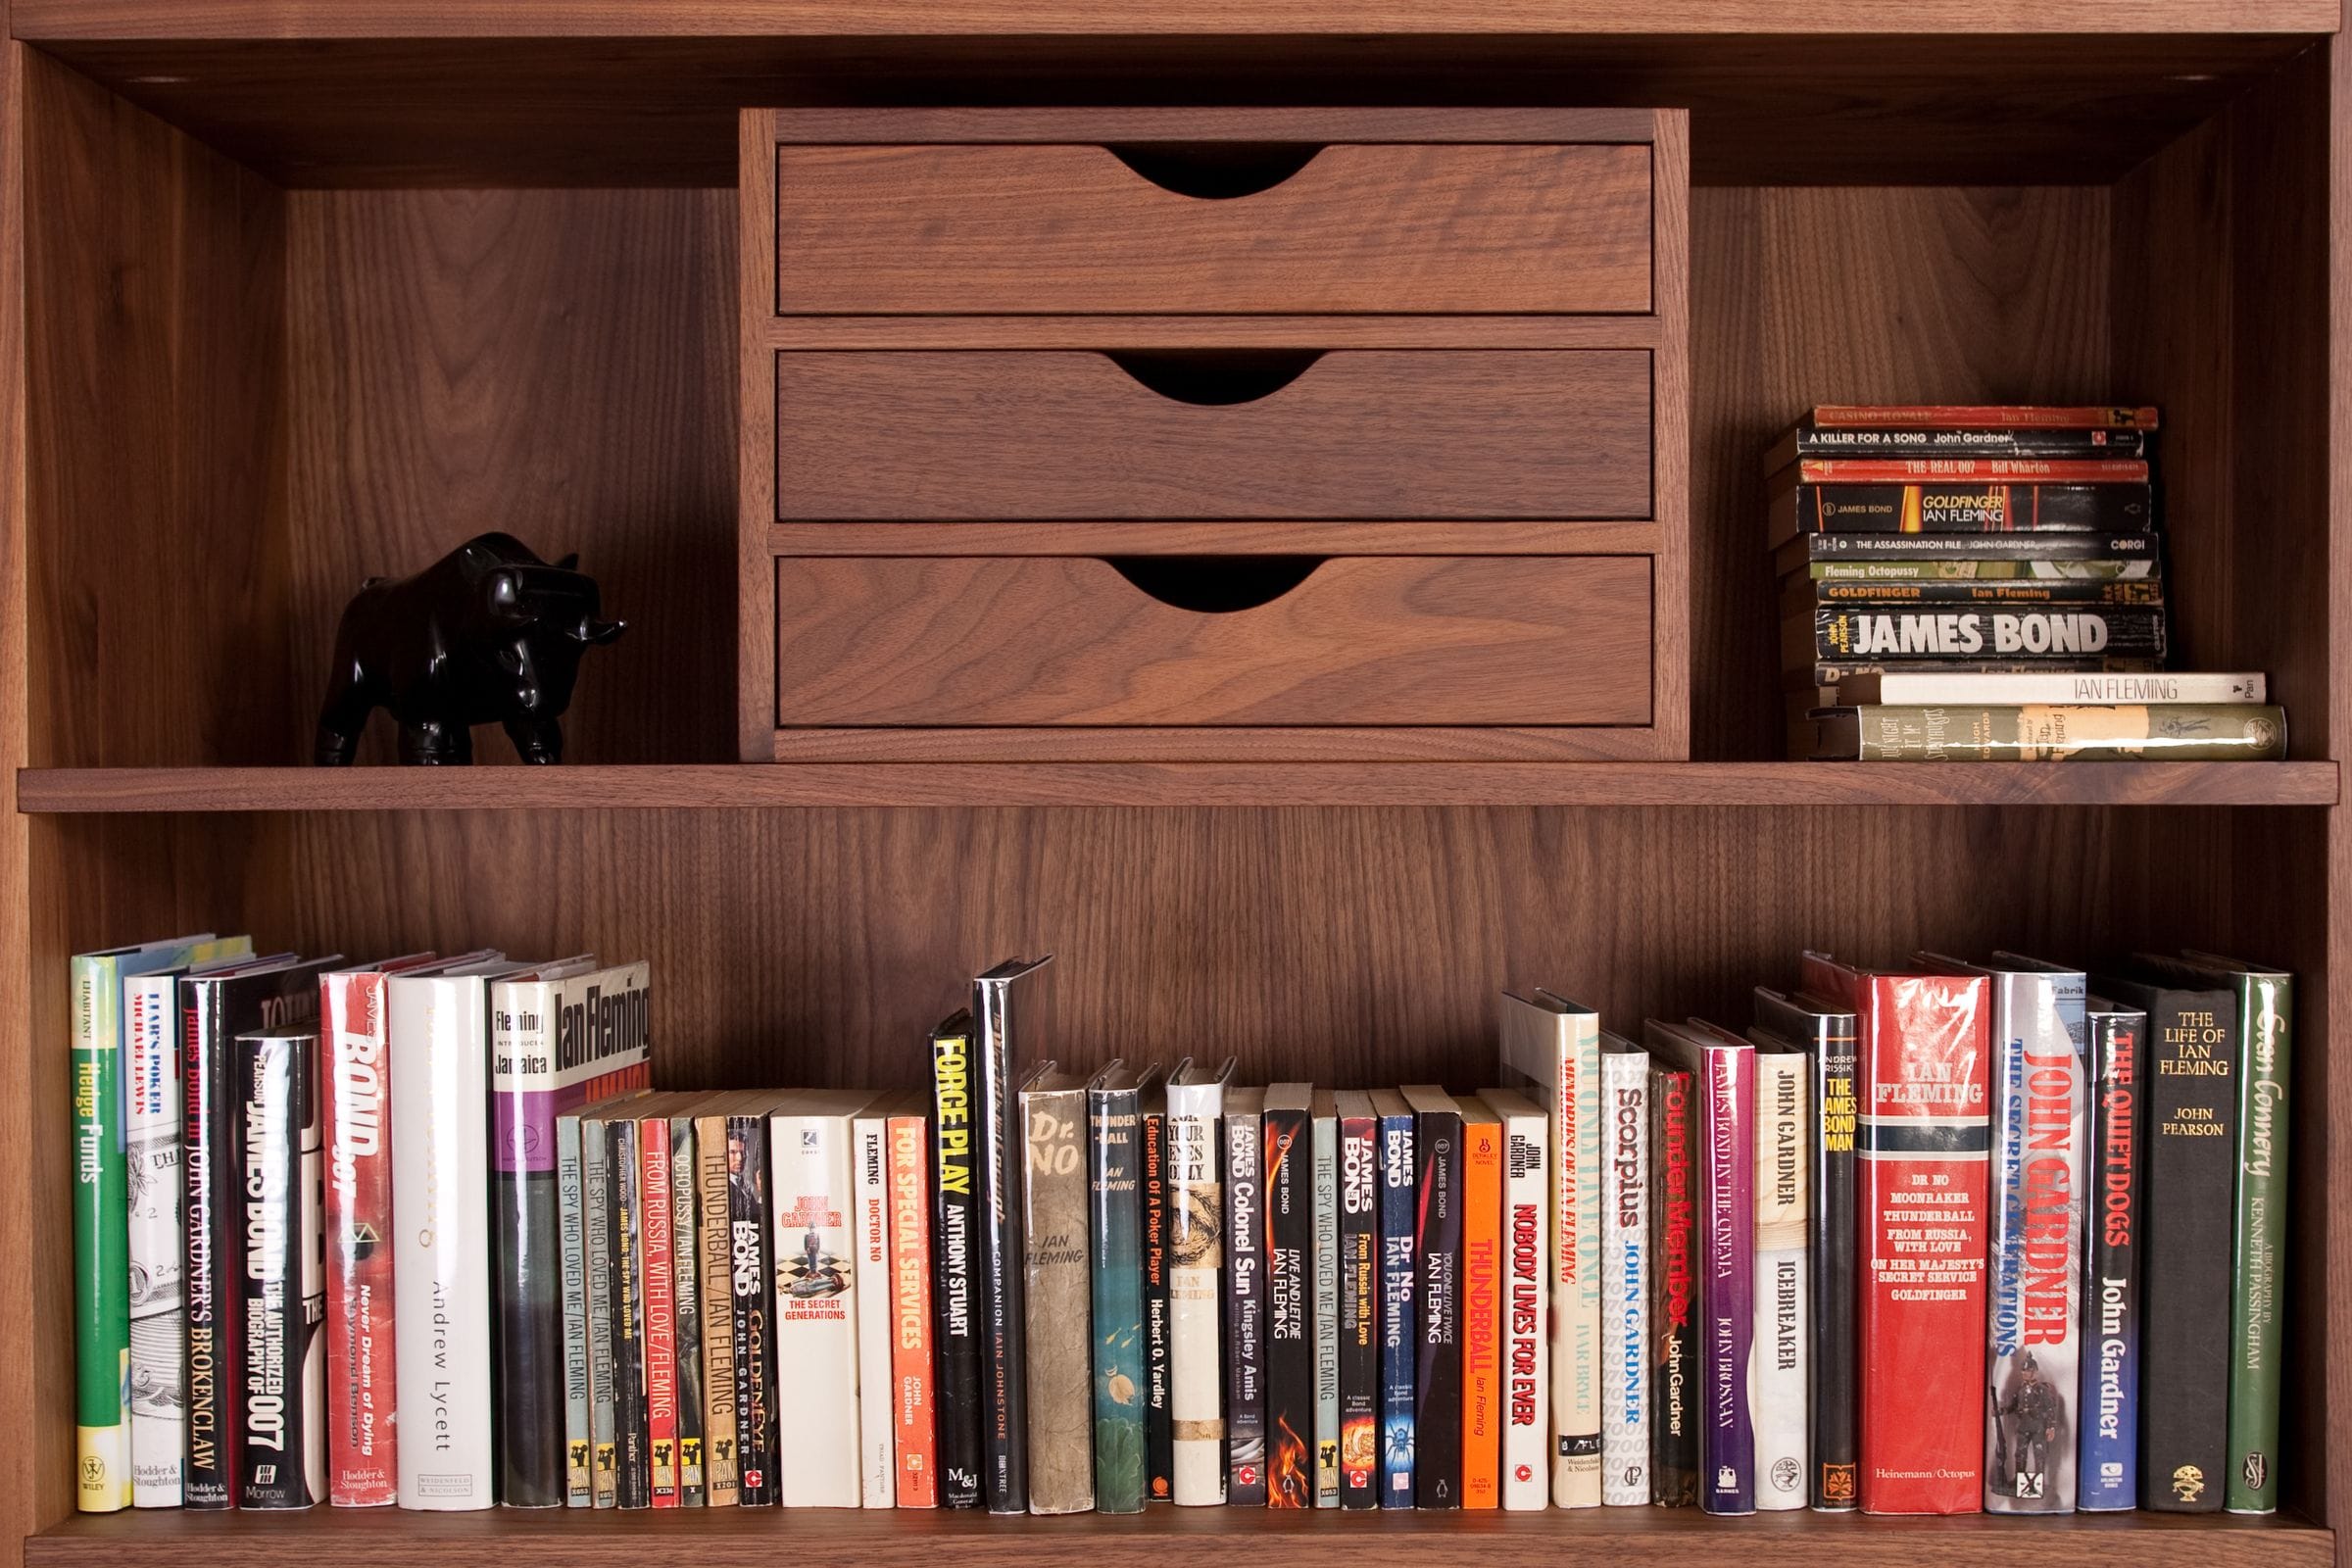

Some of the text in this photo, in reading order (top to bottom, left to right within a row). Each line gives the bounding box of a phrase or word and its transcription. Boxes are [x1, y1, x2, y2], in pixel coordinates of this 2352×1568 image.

[1809, 433, 1927, 444] A KILLER FOR A SONG
[1935, 433, 2008, 444] John Gardner
[1906, 461, 1975, 473] THE REAL 007
[1991, 461, 2050, 473] Bill Wharton
[1923, 496, 2003, 509] GOLDFINGER
[1923, 510, 2003, 521] IAN FLEMING
[1825, 565, 1919, 577] Fleming Octopussy
[1829, 588, 1921, 597] GOLDFINGER
[1972, 588, 2050, 600] Ian Fleming
[1838, 614, 1849, 653] PEARSON
[1853, 614, 1983, 654] JAMES
[1993, 613, 2107, 654] BOND
[2075, 678, 2178, 700] IAN FLEMING
[2244, 679, 2254, 699] Pan
[82, 980, 93, 1040] LHABITANT
[555, 977, 650, 1071] Ian Fleming
[2178, 1012, 2213, 1027] THE
[133, 993, 146, 1115] MICHAEL LEWIS
[148, 993, 163, 1114] LIAR'S POKER
[2164, 1028, 2226, 1043] LIFE OF
[2179, 1045, 2211, 1059] IAN
[1827, 1078, 1851, 1096] THE
[1907, 1062, 1951, 1082] IAN
[2159, 1059, 2230, 1076] FLEMING
[1877, 1083, 1984, 1103] FLEMING
[2174, 1108, 2213, 1120] JOHN
[75, 1062, 103, 1184] Hedge Funds
[935, 1038, 970, 1195] FORCE PLAY
[1029, 1111, 1074, 1144] Dr.
[1777, 1070, 1795, 1206] JOHN GARDNER
[1824, 1115, 1855, 1133] BOND
[2163, 1123, 2224, 1136] PEARSON
[2243, 1080, 2282, 1177] Connery
[866, 1134, 879, 1185] FLEMING
[1029, 1144, 1079, 1176] NO
[1231, 1124, 1246, 1179] BOND
[1244, 1124, 1254, 1178] JAMES
[1387, 1129, 1402, 1189] BOND
[1401, 1129, 1414, 1187] JAMES
[1510, 1135, 1526, 1179] GARDNER
[1526, 1144, 1542, 1170] JOHN
[1825, 1134, 1854, 1152] MAN
[2102, 1032, 2133, 1248] THE QUIET DOGS
[1344, 1137, 1361, 1214] BOND
[1360, 1138, 1373, 1212] JAMES
[1578, 1035, 1600, 1309] YOU ONLY LIVE ONCE
[1911, 1174, 1949, 1186] DR NO
[794, 1196, 829, 1212] JOHN
[1146, 1117, 1164, 1286] Education Of A Poker Player
[1884, 1210, 1975, 1222] THUNDERBALL
[1890, 1193, 1969, 1204] MOONRAKER
[2024, 1051, 2073, 1346] JOHN GARDNER
[868, 1199, 881, 1261] DOCTOR NO
[895, 1127, 922, 1349] FOR SPECIAL SERVICES
[1042, 1234, 1069, 1249] IAN
[1234, 1182, 1255, 1296] Colonel Sun
[1894, 1241, 1962, 1253] WITH LOVE
[733, 1221, 750, 1297] BOND
[947, 1204, 968, 1337] ANTHONY STUART
[1024, 1247, 1085, 1266] FLEMING
[1399, 1236, 1414, 1301] Dr No
[1614, 1089, 1644, 1425] Scorpius JOHN GARDNER
[1871, 1258, 1984, 1271] ON HER MAJESTY'S
[1878, 1271, 1978, 1283] SECRET SERVICE
[789, 1299, 841, 1309] THE SECRET
[1289, 1249, 1301, 1340] LIVE AND LET DIE
[1357, 1234, 1371, 1346] From Russia with Love
[1890, 1289, 1967, 1301] GOLDFINGER
[2246, 1197, 2265, 1370] KENNETH PASSINGHAM
[785, 1309, 846, 1321] GENERATIONS
[1469, 1239, 1494, 1374] THUNDERBALL
[1511, 1203, 1538, 1427] NOBODY LIVES FOR EVER
[1777, 1260, 1796, 1372] ICEBREAKER
[361, 1286, 375, 1456] Never Dream of Dying
[431, 1281, 451, 1451] Andrew Lycett
[1151, 1299, 1166, 1409] Herbert O. Yardley
[1242, 1299, 1257, 1401] Kingsley Amis
[2099, 1277, 2127, 1440] John Gardner
[247, 1298, 284, 1451] BIOGRAPHY OF 007
[736, 1309, 750, 1455] JOHN GARDNER
[912, 1376, 922, 1405] JOHN
[903, 1377, 913, 1425] GARDNER
[1474, 1376, 1488, 1437] Ian Fleming
[245, 1486, 286, 1499] Morrow
